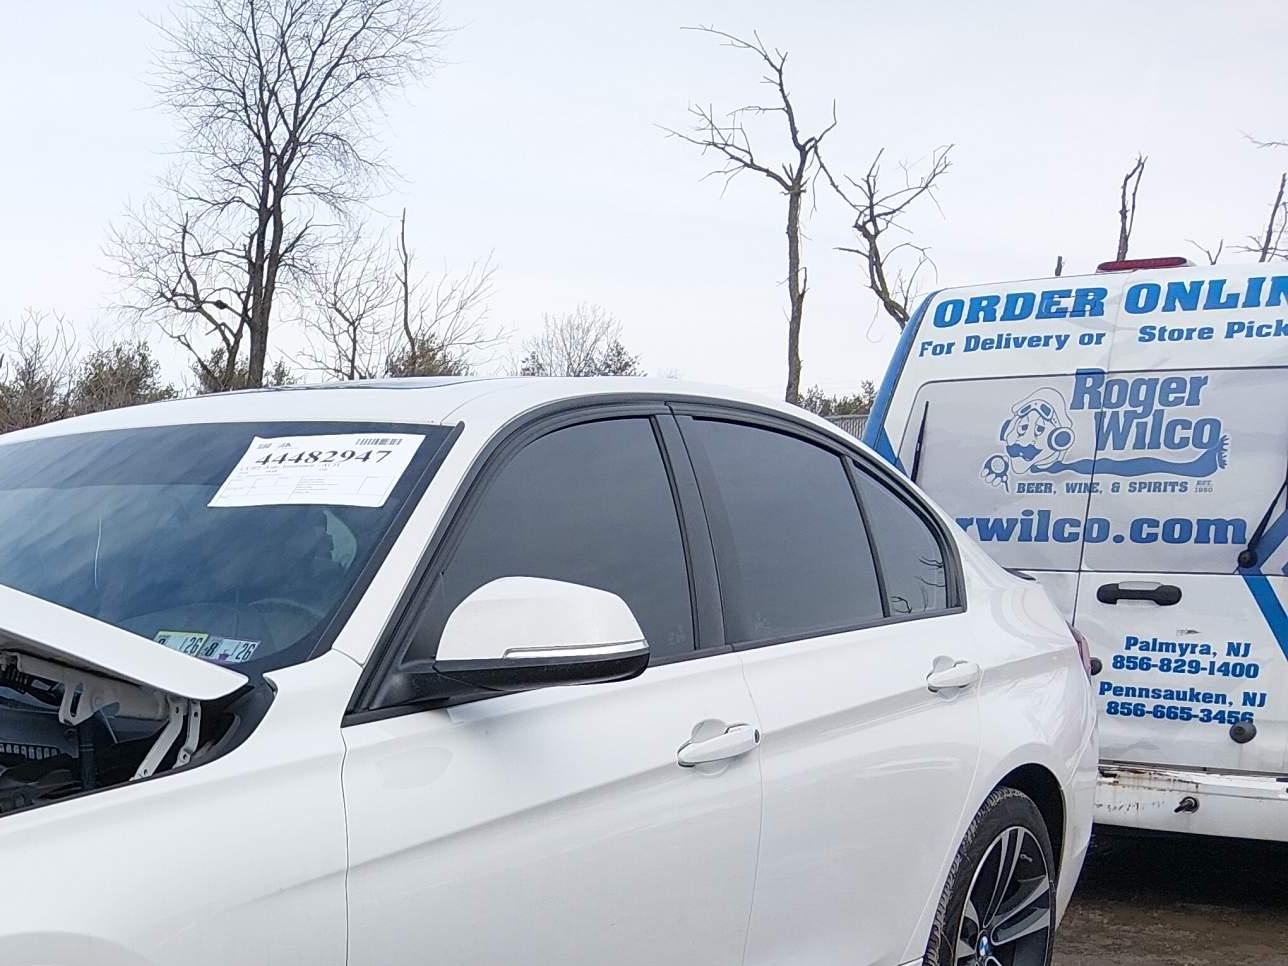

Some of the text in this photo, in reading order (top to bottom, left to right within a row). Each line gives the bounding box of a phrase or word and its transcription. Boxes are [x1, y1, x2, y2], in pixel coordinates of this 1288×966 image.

[933, 287, 1108, 328] ORDER
[919, 341, 956, 357] For
[964, 333, 1070, 353] Delivery
[1079, 332, 1106, 346] or
[1138, 325, 1214, 343] Store
[1070, 368, 1208, 419] Roger
[1094, 408, 1222, 451] Wilco
[256, 449, 393, 466] 44482947
[1015, 480, 1189, 495] BEER, WINE, & SPIRITS
[235, 643, 256, 661] 26
[1125, 636, 1252, 659] Palmyra, NJ
[1112, 654, 1259, 679] 856-829-1400
[1099, 681, 1267, 708] Pennsauken, NJ
